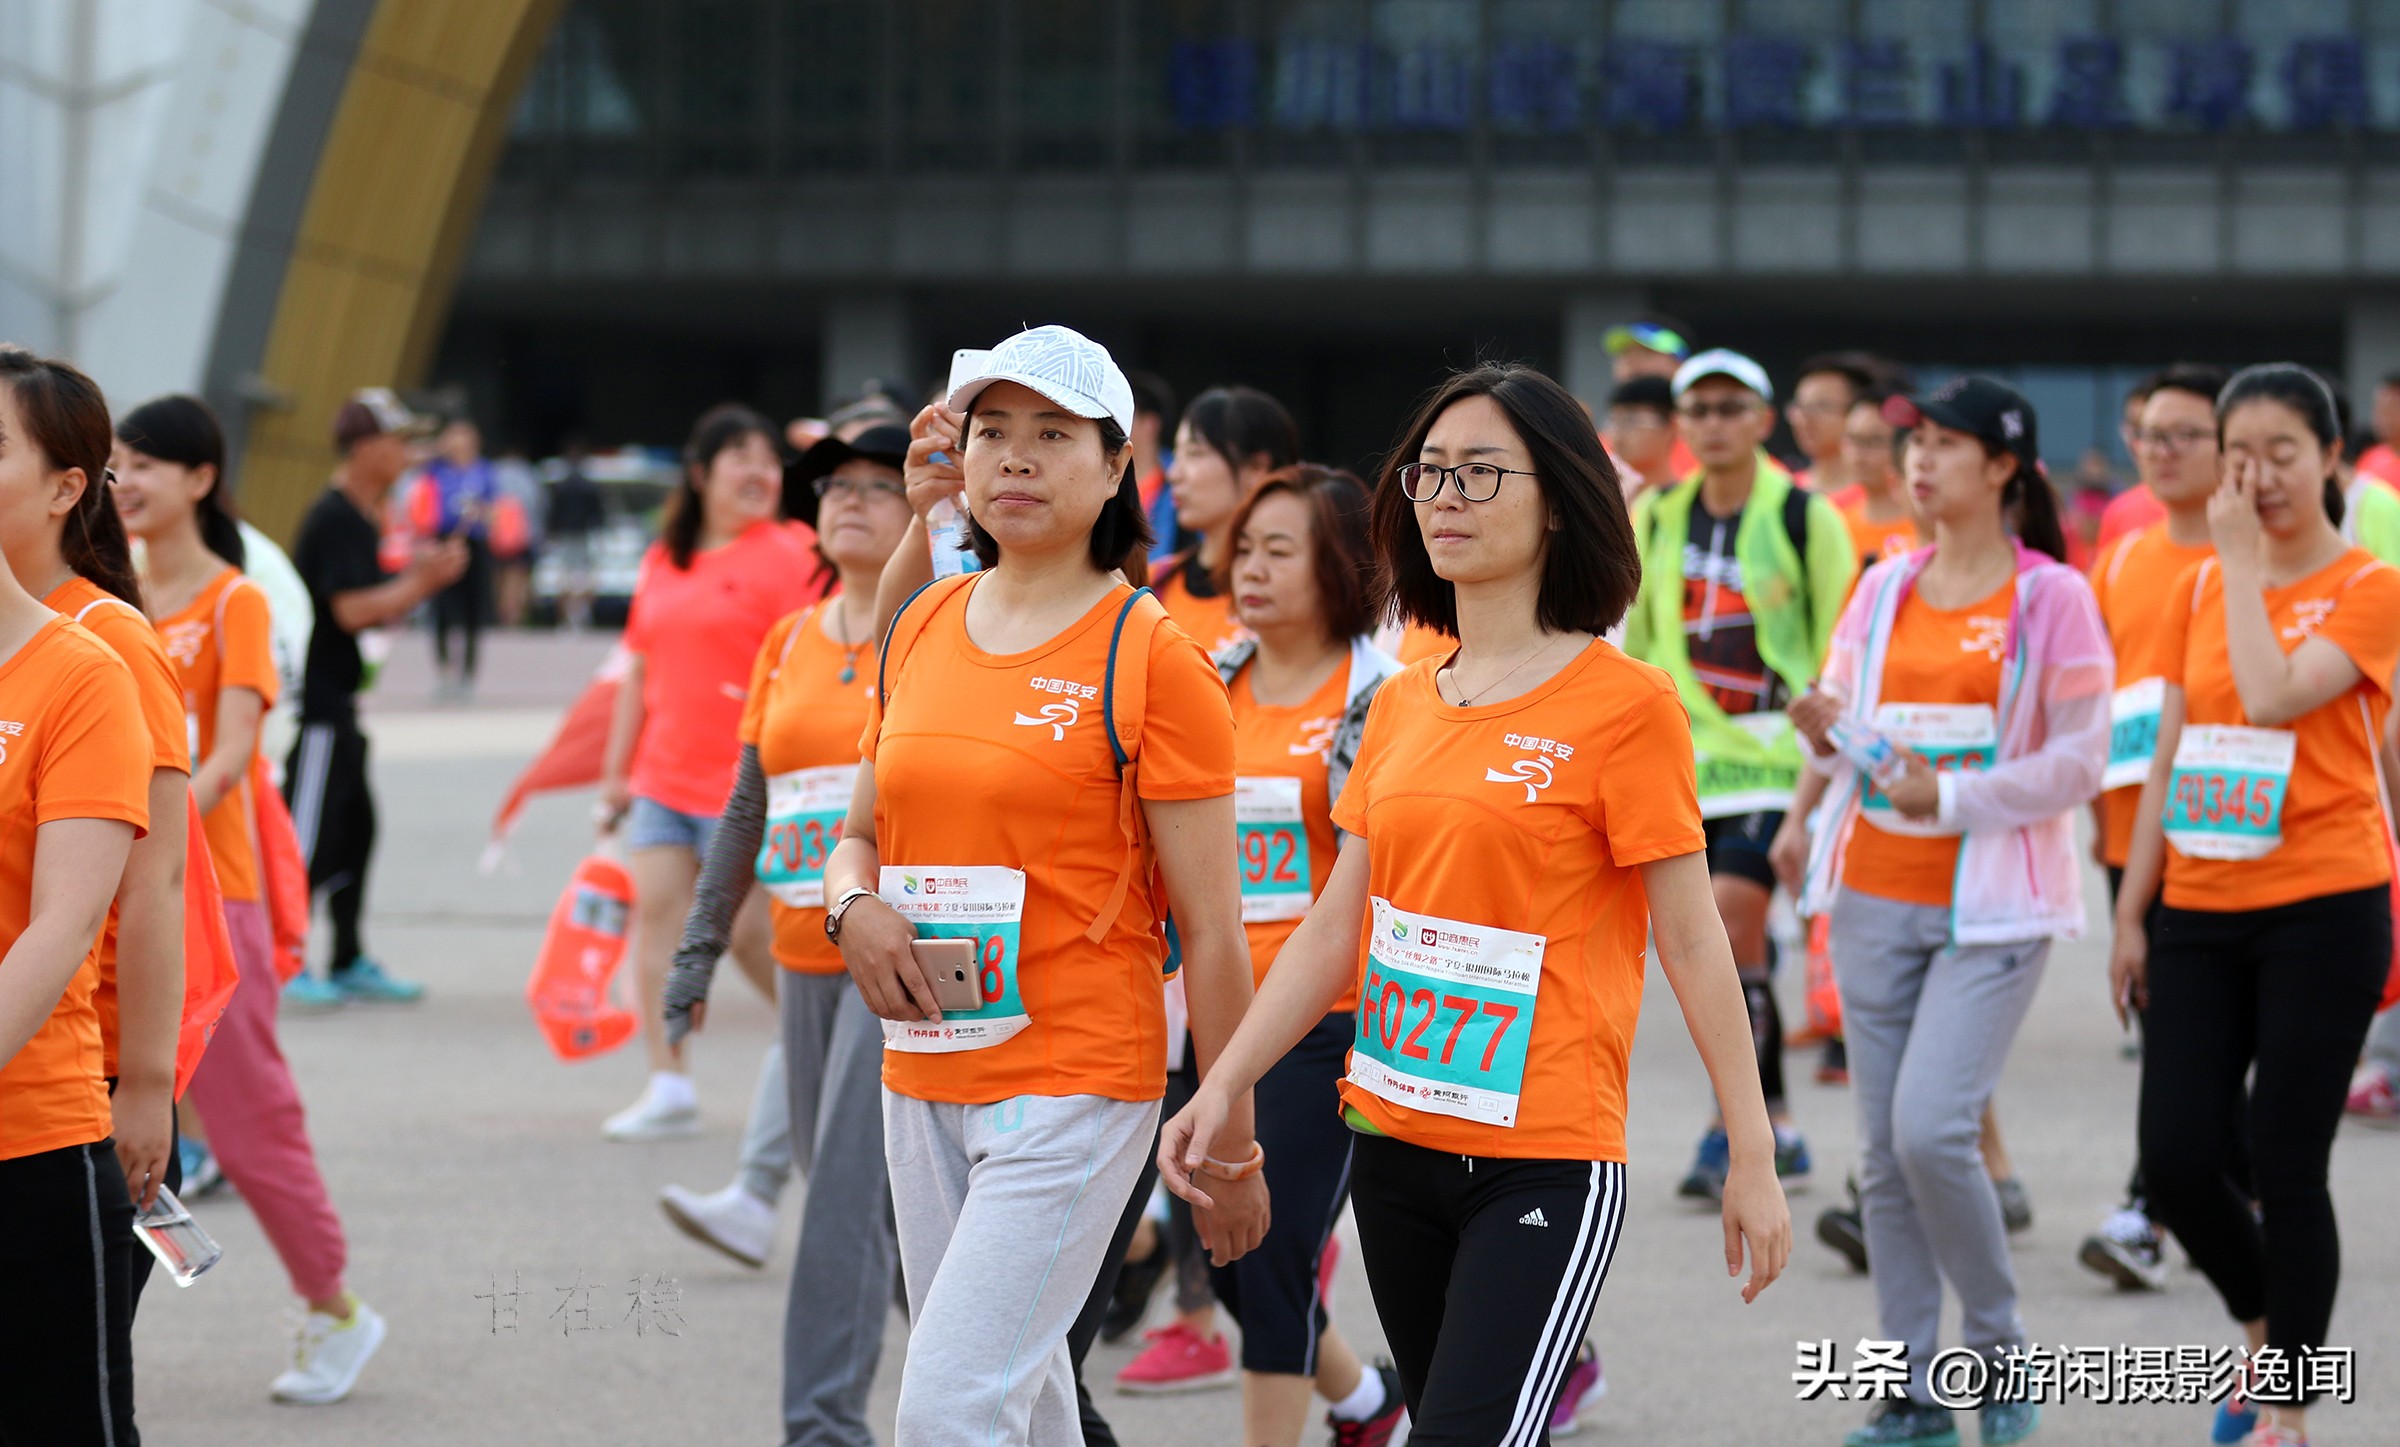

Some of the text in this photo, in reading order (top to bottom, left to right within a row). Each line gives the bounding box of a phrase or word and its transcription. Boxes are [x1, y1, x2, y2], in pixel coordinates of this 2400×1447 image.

[1030, 677, 1098, 700] 中国平安
[1503, 733, 1575, 762] 中国平安
[2167, 773, 2275, 828] F0345
[1237, 829, 1298, 883] 92
[1363, 971, 1519, 1072] F0277
[1518, 1216, 1549, 1228] adidas
